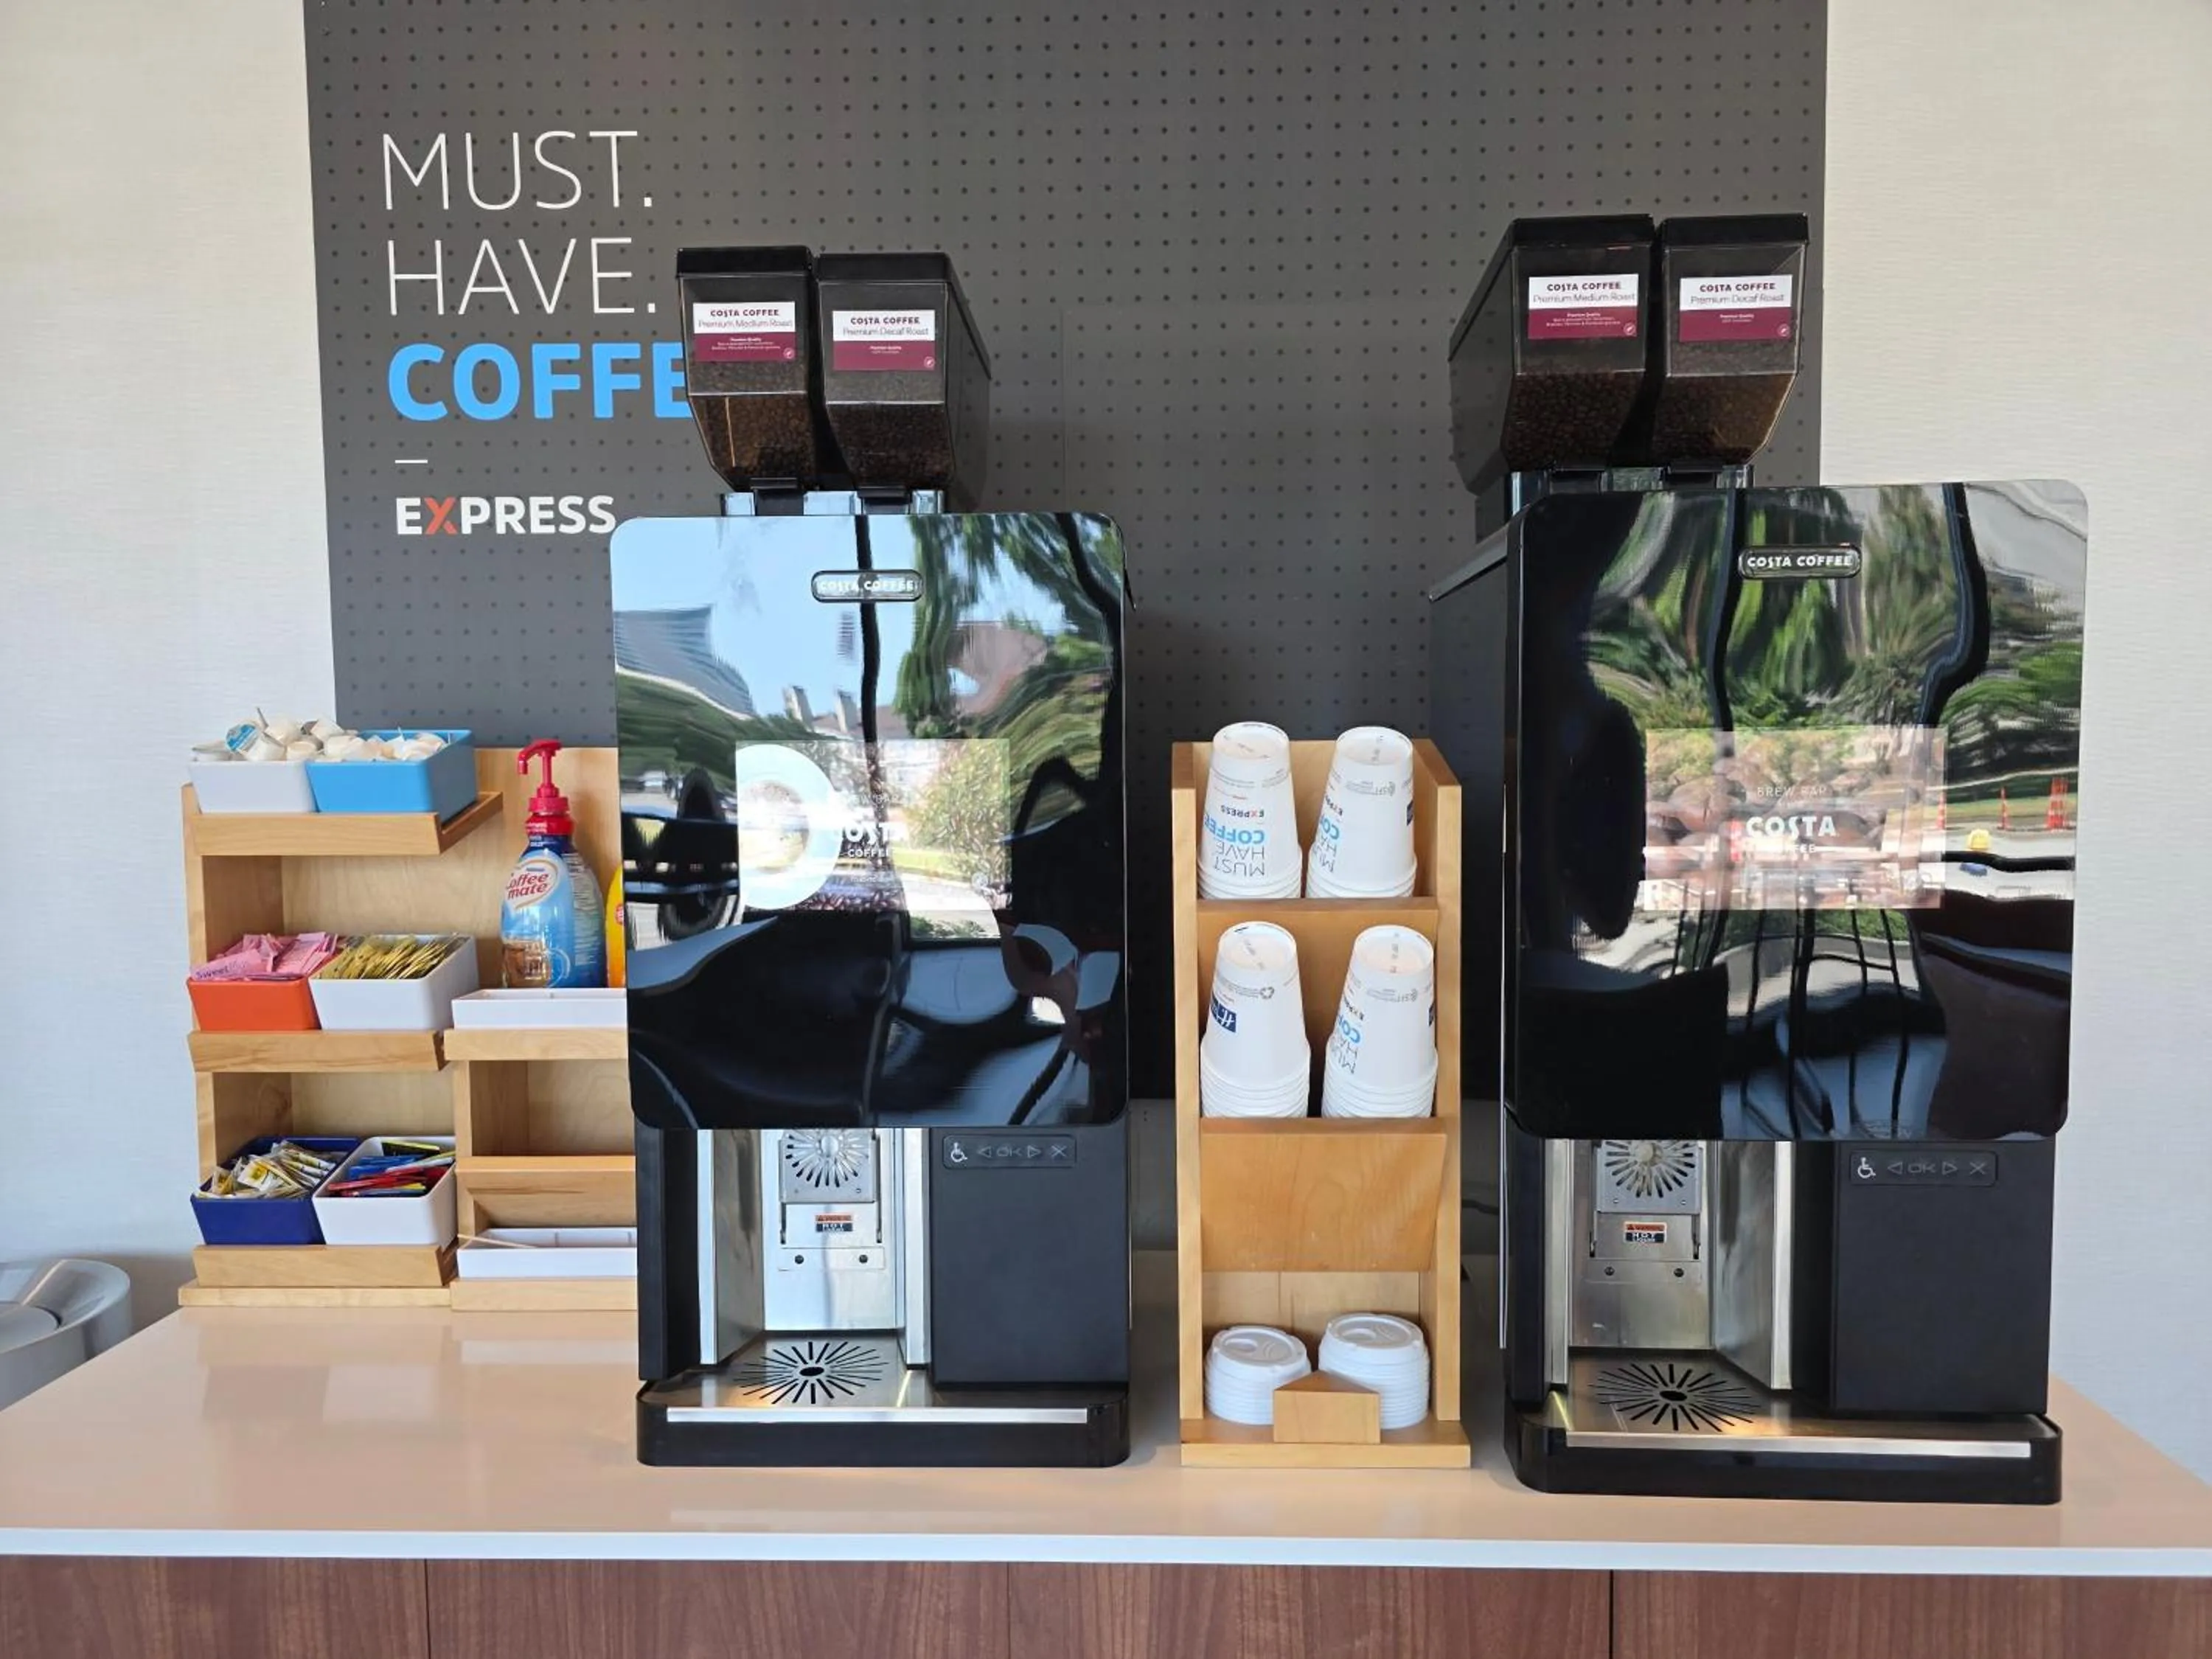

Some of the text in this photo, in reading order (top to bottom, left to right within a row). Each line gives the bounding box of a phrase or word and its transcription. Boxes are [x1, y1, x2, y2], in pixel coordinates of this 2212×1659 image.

[382, 131, 654, 211] MUST.
[388, 237, 656, 315] HAVE.
[1547, 282, 1622, 292] COSTA COFFEE
[1700, 282, 1776, 293] COSTA COFFEE
[1533, 292, 1635, 303] Premium Medium Roast
[1733, 293, 1757, 303] Decaf
[710, 309, 740, 318] COSTA
[850, 316, 920, 325] COSTA COFFEE
[389, 343, 694, 420] COFFE
[396, 495, 617, 535] EXPRESS
[1747, 555, 1853, 568] COSTA COFFEE
[863, 580, 914, 591] COFFEE
[1220, 804, 1265, 818] EXPRESS
[1746, 815, 1837, 841] COSTA
[1214, 837, 1265, 860] HAVE
[1214, 856, 1265, 877] MUST
[504, 872, 549, 890] offee
[507, 883, 548, 900] mate
[996, 1146, 1022, 1157] OK
[1907, 1163, 1936, 1173] OK
